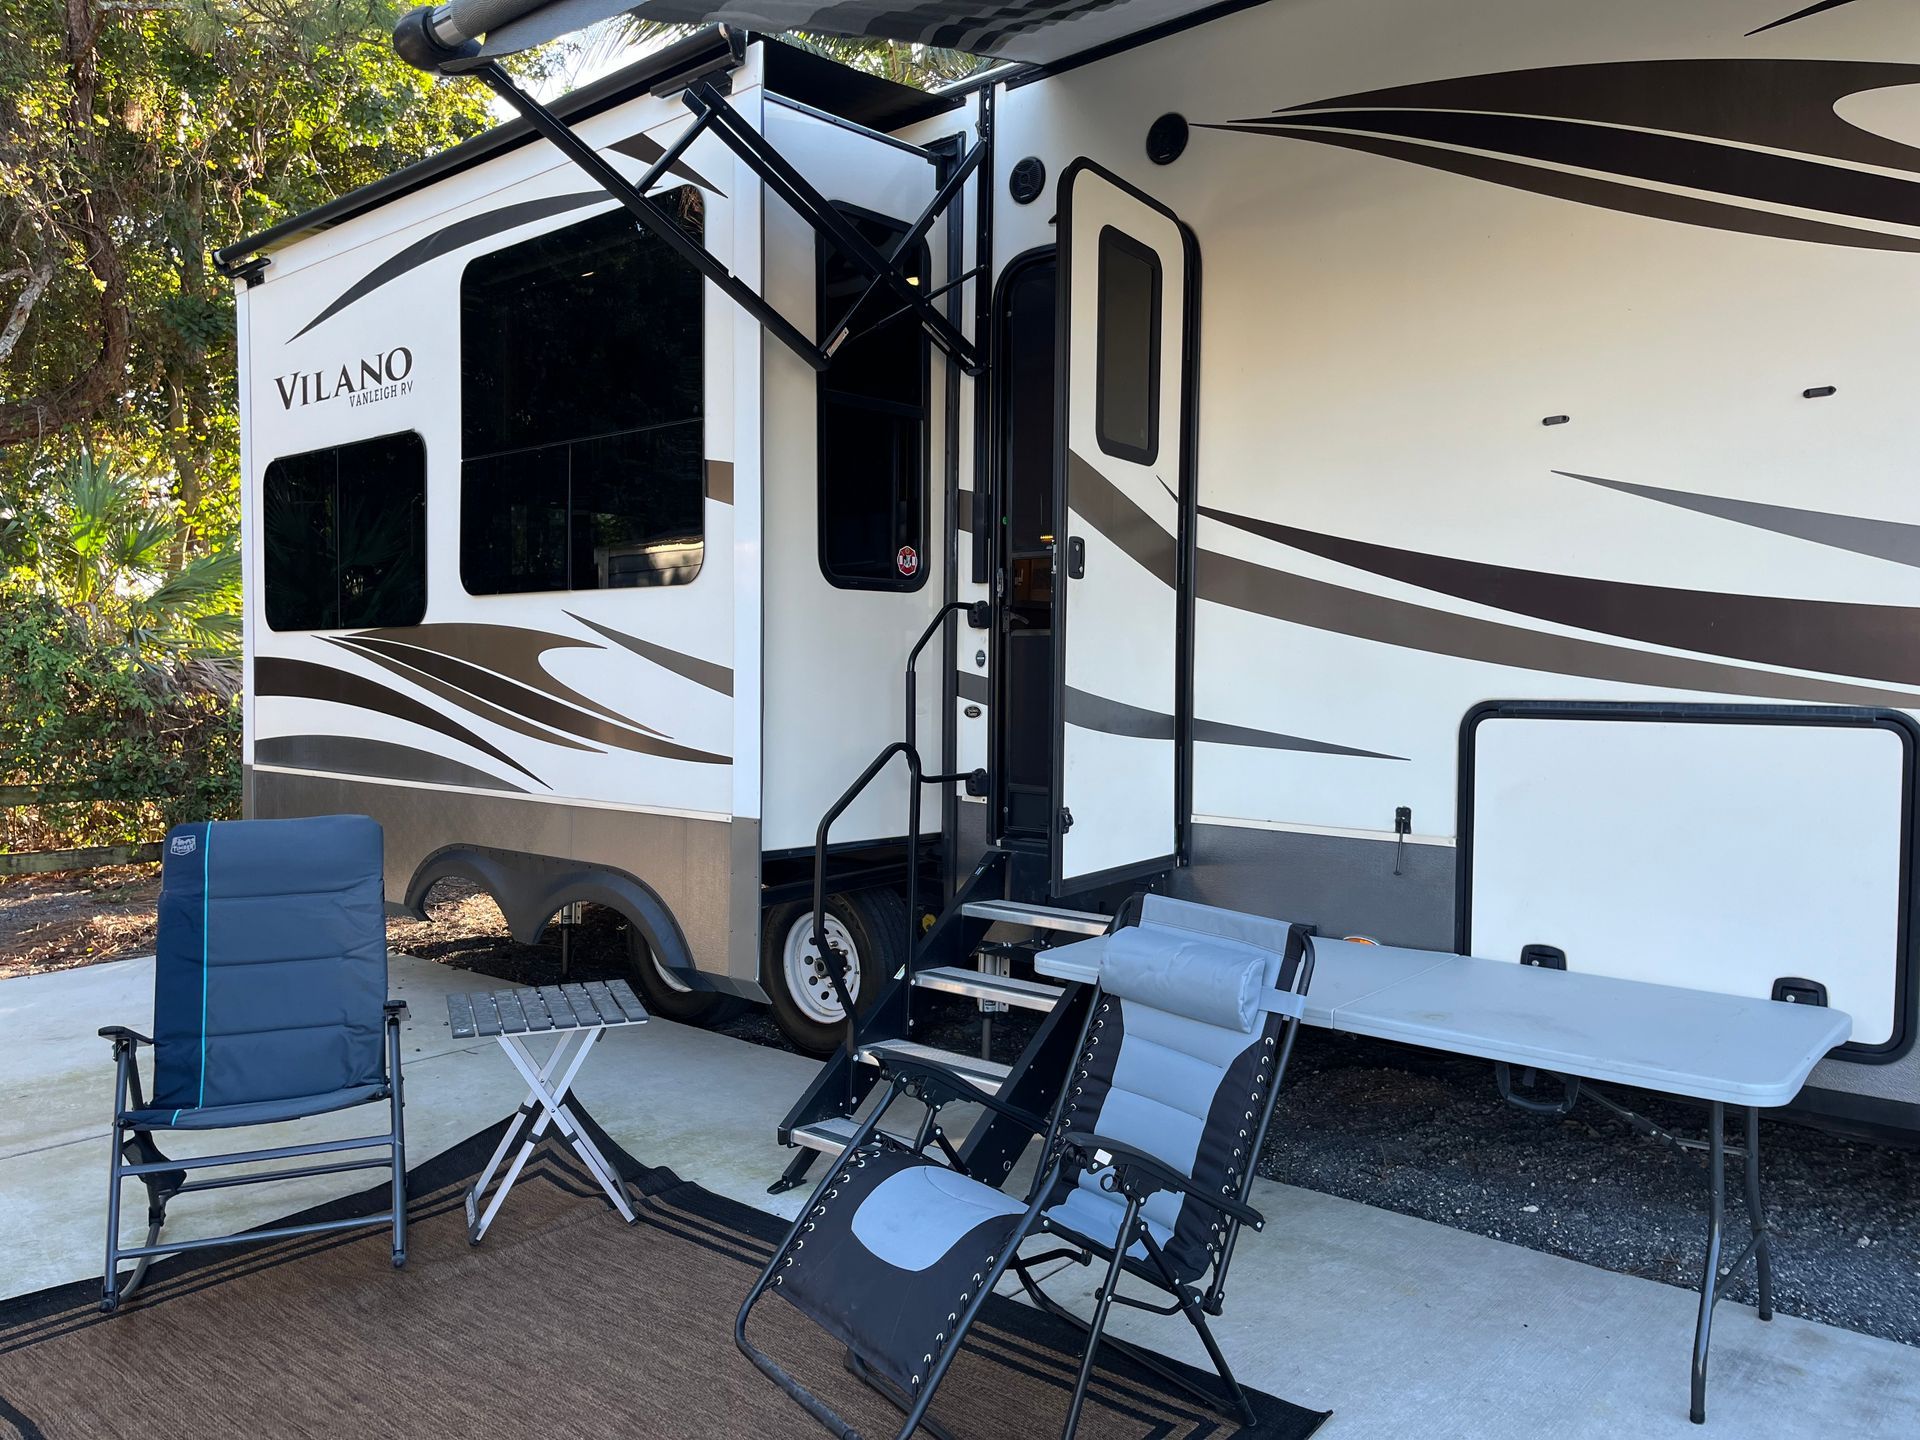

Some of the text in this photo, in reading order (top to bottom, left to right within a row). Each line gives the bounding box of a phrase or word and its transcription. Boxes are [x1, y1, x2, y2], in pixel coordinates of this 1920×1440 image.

[274, 347, 413, 410] VILANO
[350, 380, 413, 408] VANLEIGH RV
